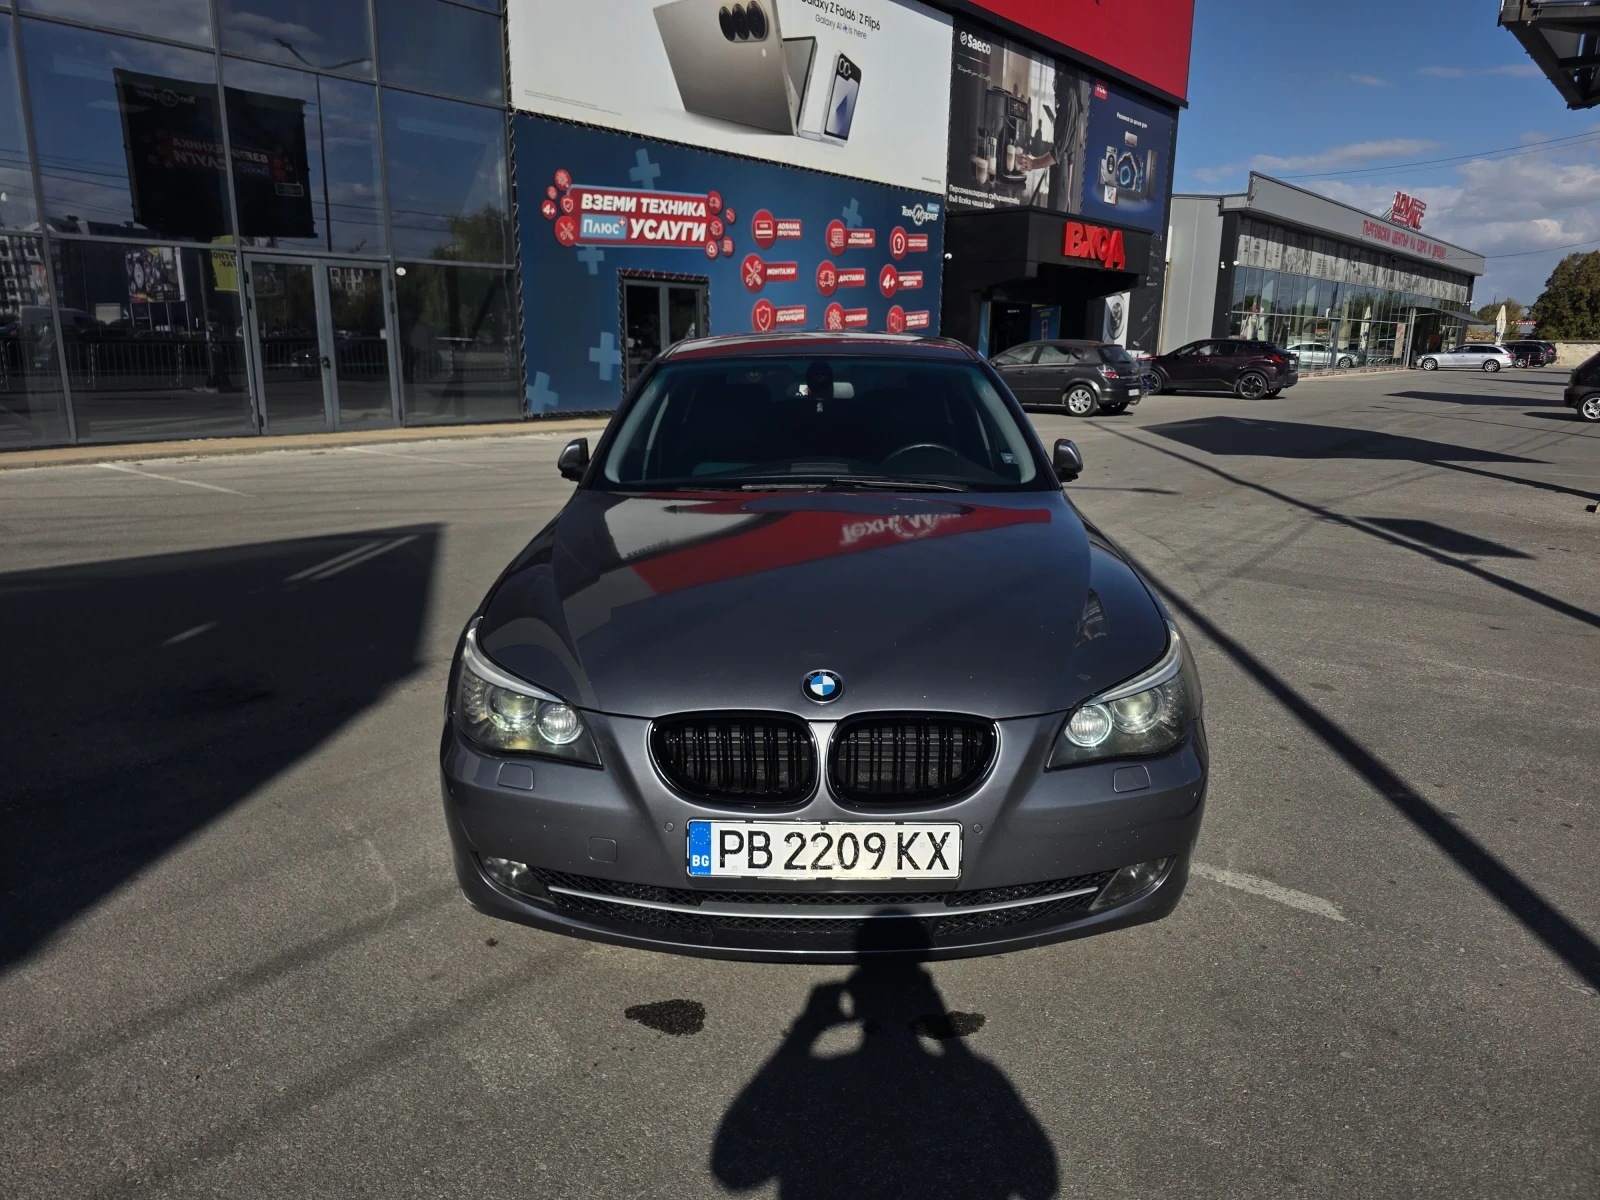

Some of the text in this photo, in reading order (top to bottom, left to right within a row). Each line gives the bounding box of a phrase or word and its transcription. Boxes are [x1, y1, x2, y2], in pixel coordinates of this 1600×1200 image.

[815, 14, 836, 30] Galaxy
[853, 28, 867, 39] here
[830, 2, 835, 13] Z
[835, 4, 856, 21] Fold6
[859, 13, 864, 24] Z
[864, 15, 881, 31] Flip6
[967, 33, 991, 55] Saeco
[581, 193, 706, 217] ВЗЕМИ ТЕХНИКА
[583, 218, 707, 242] Плюс УСЛУГИ
[1065, 222, 1125, 270] ВХОД
[767, 267, 796, 275] МОНТАЖИ
[838, 274, 865, 283] ДОСТАВКА
[692, 855, 709, 867] BG
[719, 830, 951, 870] PB 2209 KX
